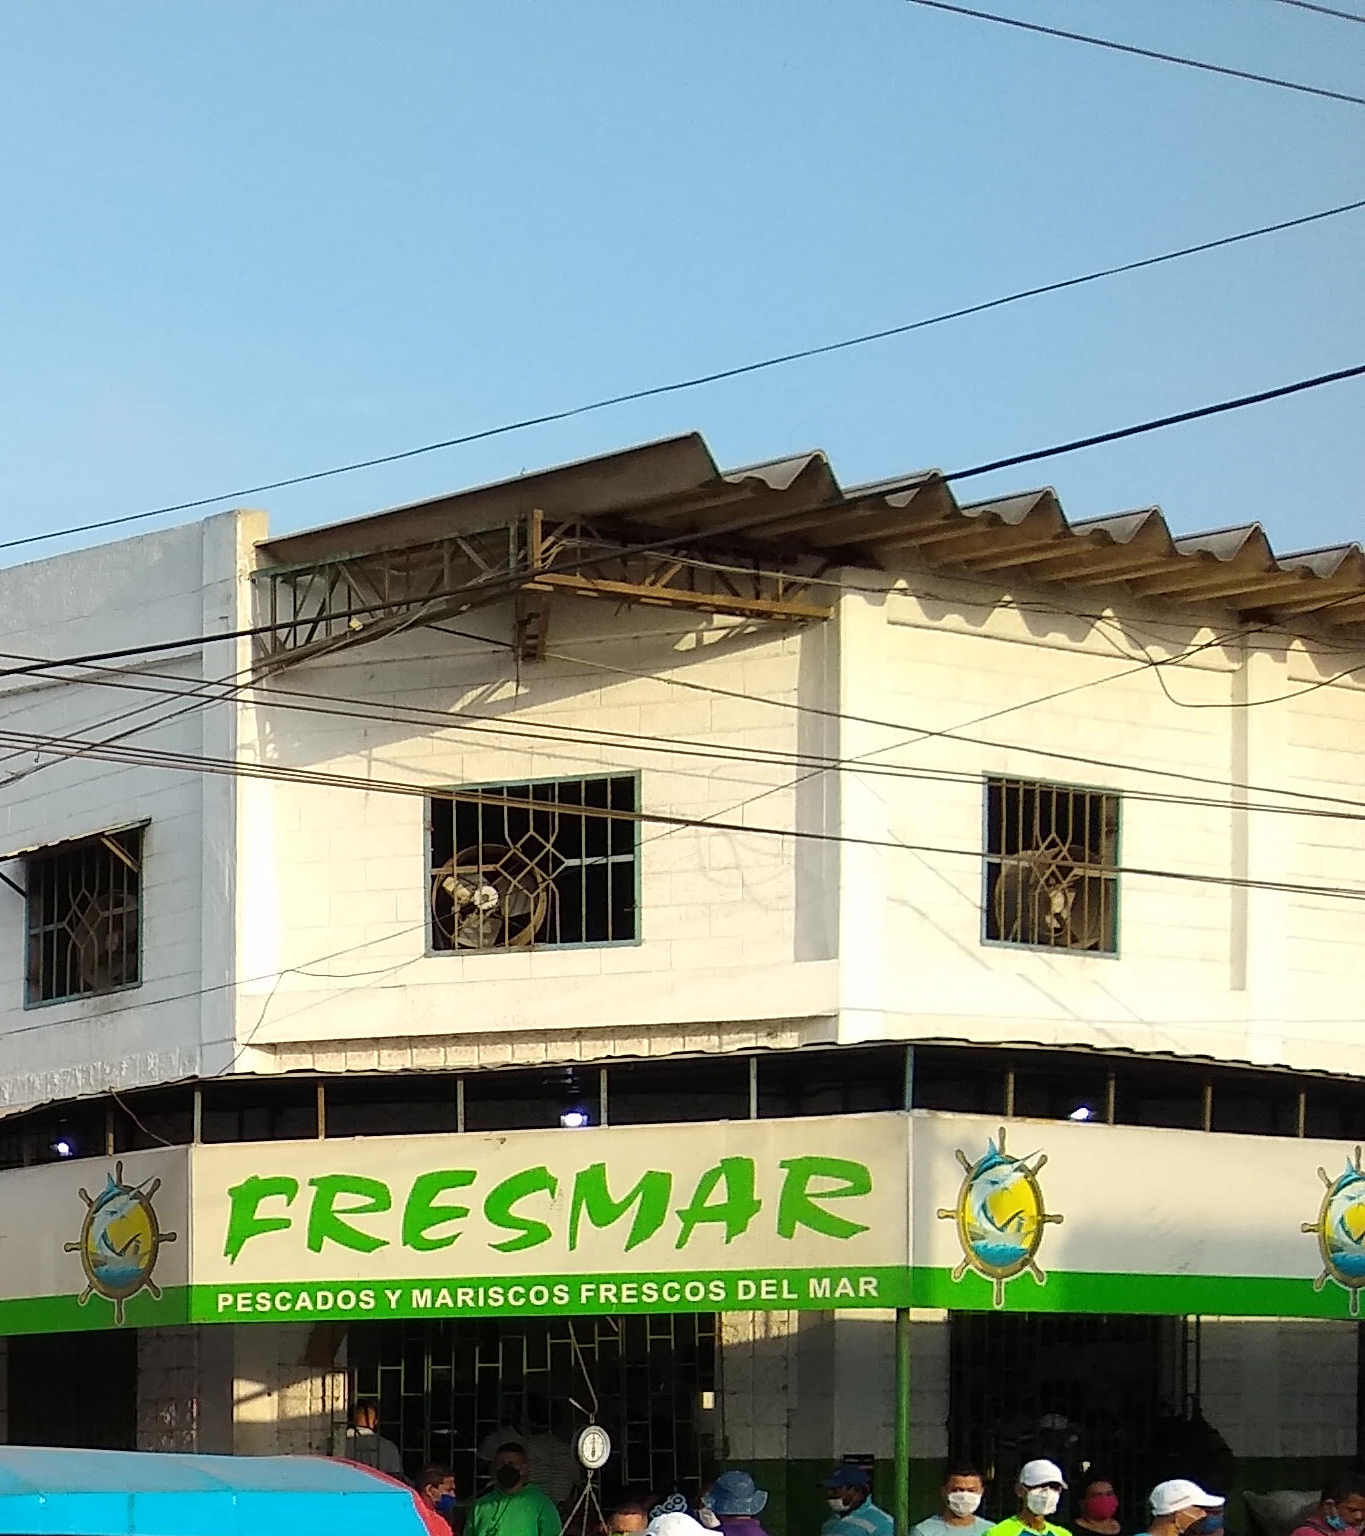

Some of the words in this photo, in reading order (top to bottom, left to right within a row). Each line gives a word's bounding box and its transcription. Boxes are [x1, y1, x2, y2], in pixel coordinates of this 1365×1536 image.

[223, 1156, 872, 1265] FRESMAR
[218, 1289, 375, 1312] PESCADOS
[385, 1289, 401, 1308] Y
[413, 1286, 569, 1307] MARISCOS
[580, 1281, 726, 1304] FRESCOS
[738, 1281, 798, 1300] DEL
[809, 1277, 879, 1298] MAR
